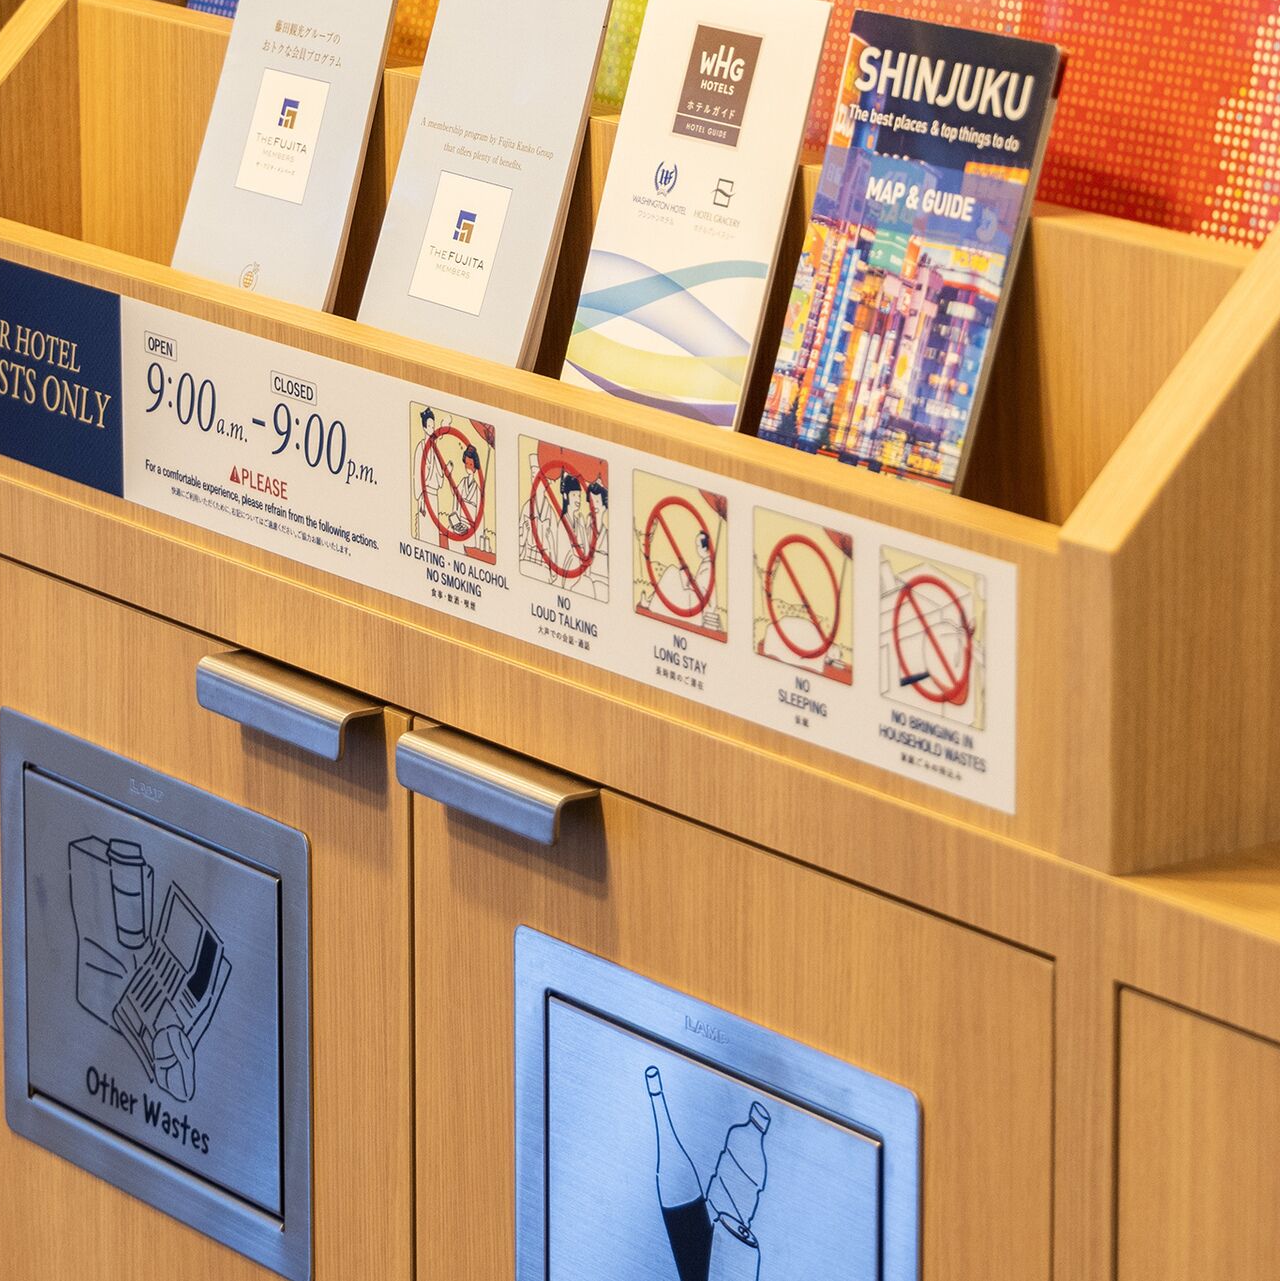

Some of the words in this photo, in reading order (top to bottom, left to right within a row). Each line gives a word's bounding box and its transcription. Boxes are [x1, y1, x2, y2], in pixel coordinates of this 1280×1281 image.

[700, 79, 736, 97] HOTELS
[854, 46, 1035, 122] SHINJUKU
[686, 100, 736, 121] ホテルガイド
[427, 119, 464, 137] membership
[464, 129, 488, 144] program
[489, 133, 497, 146] by
[497, 135, 516, 151] Fujita
[516, 140, 536, 155] Kanko
[536, 145, 555, 161] Group
[685, 122, 706, 135] HOTEL
[707, 127, 728, 140] GUIDE
[848, 103, 869, 123] The
[870, 108, 894, 128] best
[894, 114, 929, 136] places
[930, 120, 940, 138] &
[940, 123, 959, 144] top
[959, 126, 992, 151] things
[992, 134, 1004, 148] to
[1004, 135, 1021, 154] do
[443, 142, 456, 154] that
[456, 145, 472, 158] offers
[472, 149, 492, 165] plenty
[492, 154, 500, 166] of
[865, 176, 906, 206] MAP
[906, 184, 921, 212] &
[921, 188, 977, 223] GUIDE
[435, 262, 471, 281] MEMBERS
[14, 324, 81, 374] HOTEL
[148, 336, 174, 357] OPEN
[42, 374, 113, 429] ONLY
[273, 375, 315, 402] CLOSED
[241, 468, 289, 501] PLEASE
[145, 458, 156, 473] For
[162, 468, 202, 489] comfortable
[202, 481, 241, 505] experience,
[241, 494, 263, 511] please
[264, 502, 288, 519] refrain
[288, 508, 305, 525] from
[305, 515, 318, 529] the
[318, 519, 352, 543] following
[351, 530, 380, 551] actions.
[399, 541, 412, 557] NO
[414, 546, 446, 569] EATING
[453, 559, 467, 575] NO
[468, 565, 510, 591] ALCOHOL
[426, 567, 439, 583] NO
[441, 572, 482, 597] SMOKING
[557, 594, 571, 611] NO
[531, 603, 556, 623] LOUD
[558, 612, 598, 638] TALKING
[673, 634, 688, 651] NO
[653, 645, 681, 666] LONG
[682, 656, 708, 675] STAY
[795, 676, 811, 693] NO
[778, 688, 828, 717] SLEEPING
[891, 709, 906, 727] NO
[909, 715, 960, 745] BRINGING
[963, 734, 974, 750] IN
[878, 723, 942, 758] HOUSEHOLD
[944, 748, 987, 773] WASTES
[85, 1065, 139, 1115] Other
[143, 1092, 210, 1155] Wastes
